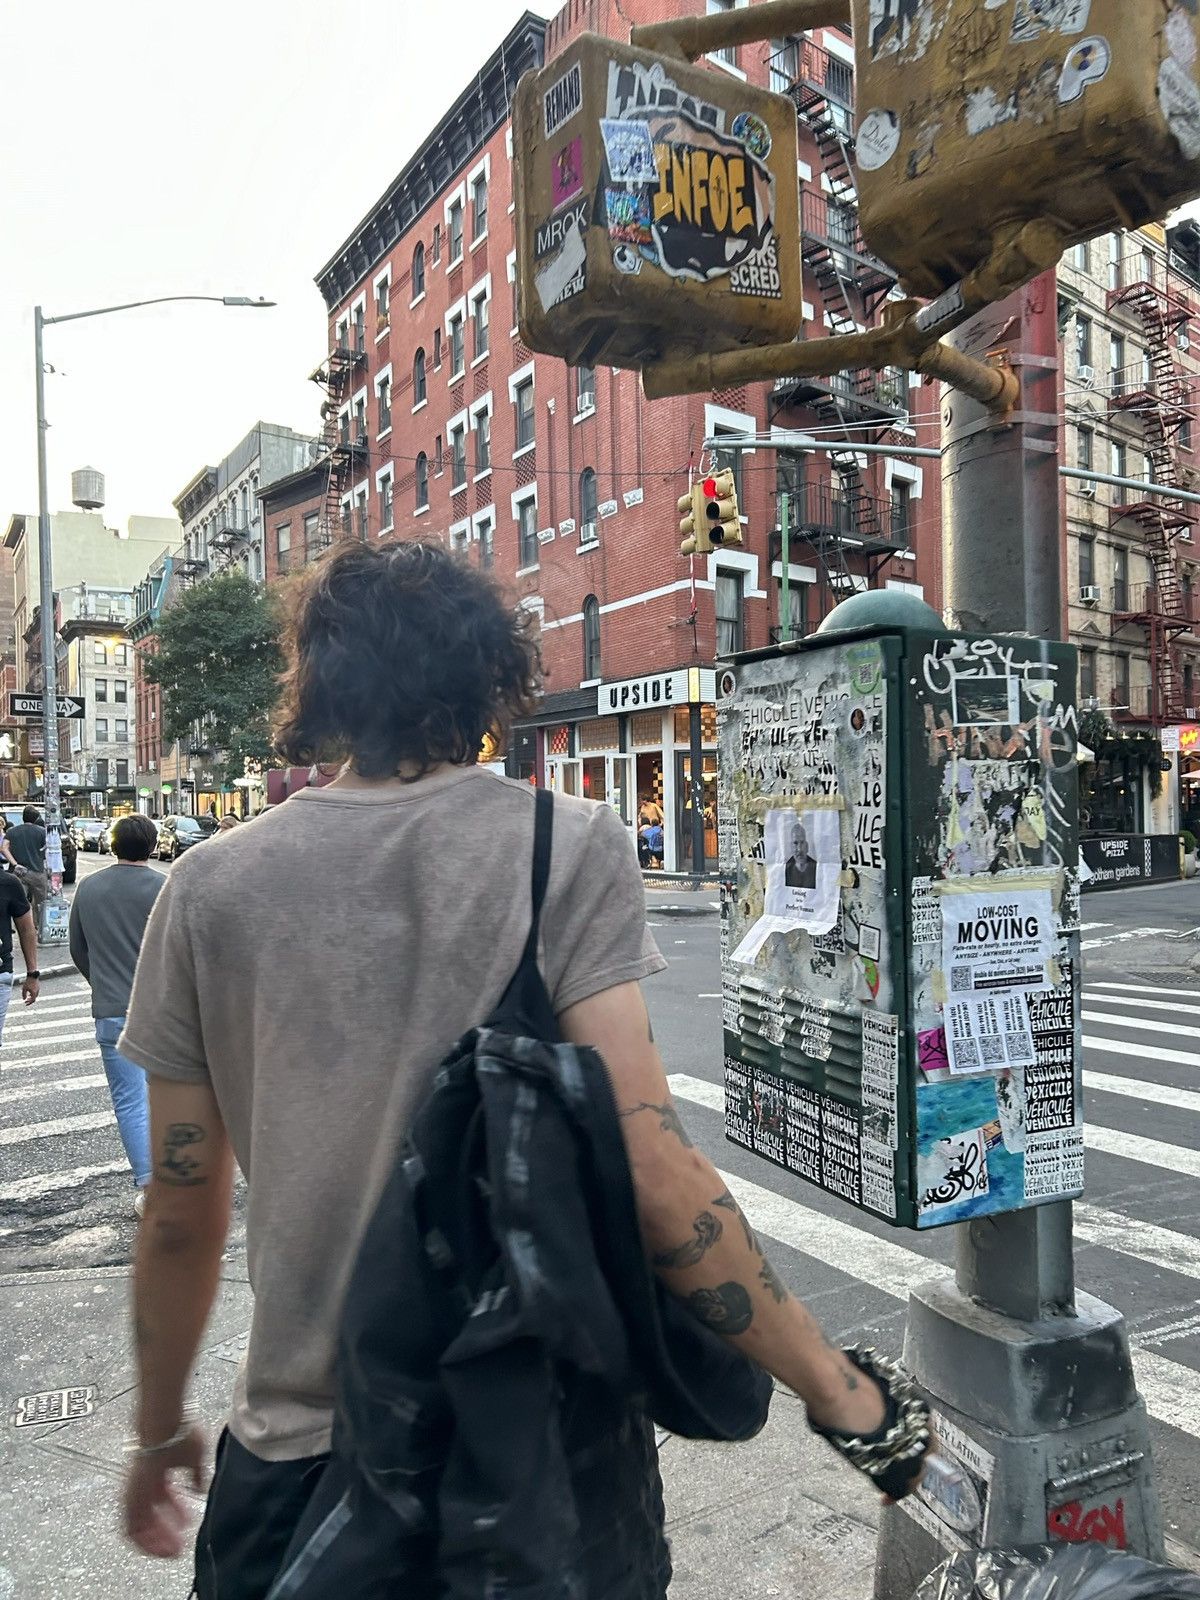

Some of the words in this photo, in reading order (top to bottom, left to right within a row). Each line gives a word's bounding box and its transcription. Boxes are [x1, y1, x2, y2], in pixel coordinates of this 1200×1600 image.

[546, 67, 580, 133] REMAND
[653, 143, 753, 233] INFOE
[538, 202, 587, 254] MROK
[730, 265, 779, 290] SCRED
[21, 700, 42, 710] ONE
[609, 677, 673, 708] UPSIDE
[1100, 840, 1129, 852] UPSIDE
[1106, 850, 1125, 858] PIZZA
[1115, 864, 1141, 881] gardens
[977, 905, 1019, 919] LOW-COST
[958, 917, 1038, 943] MOVING
